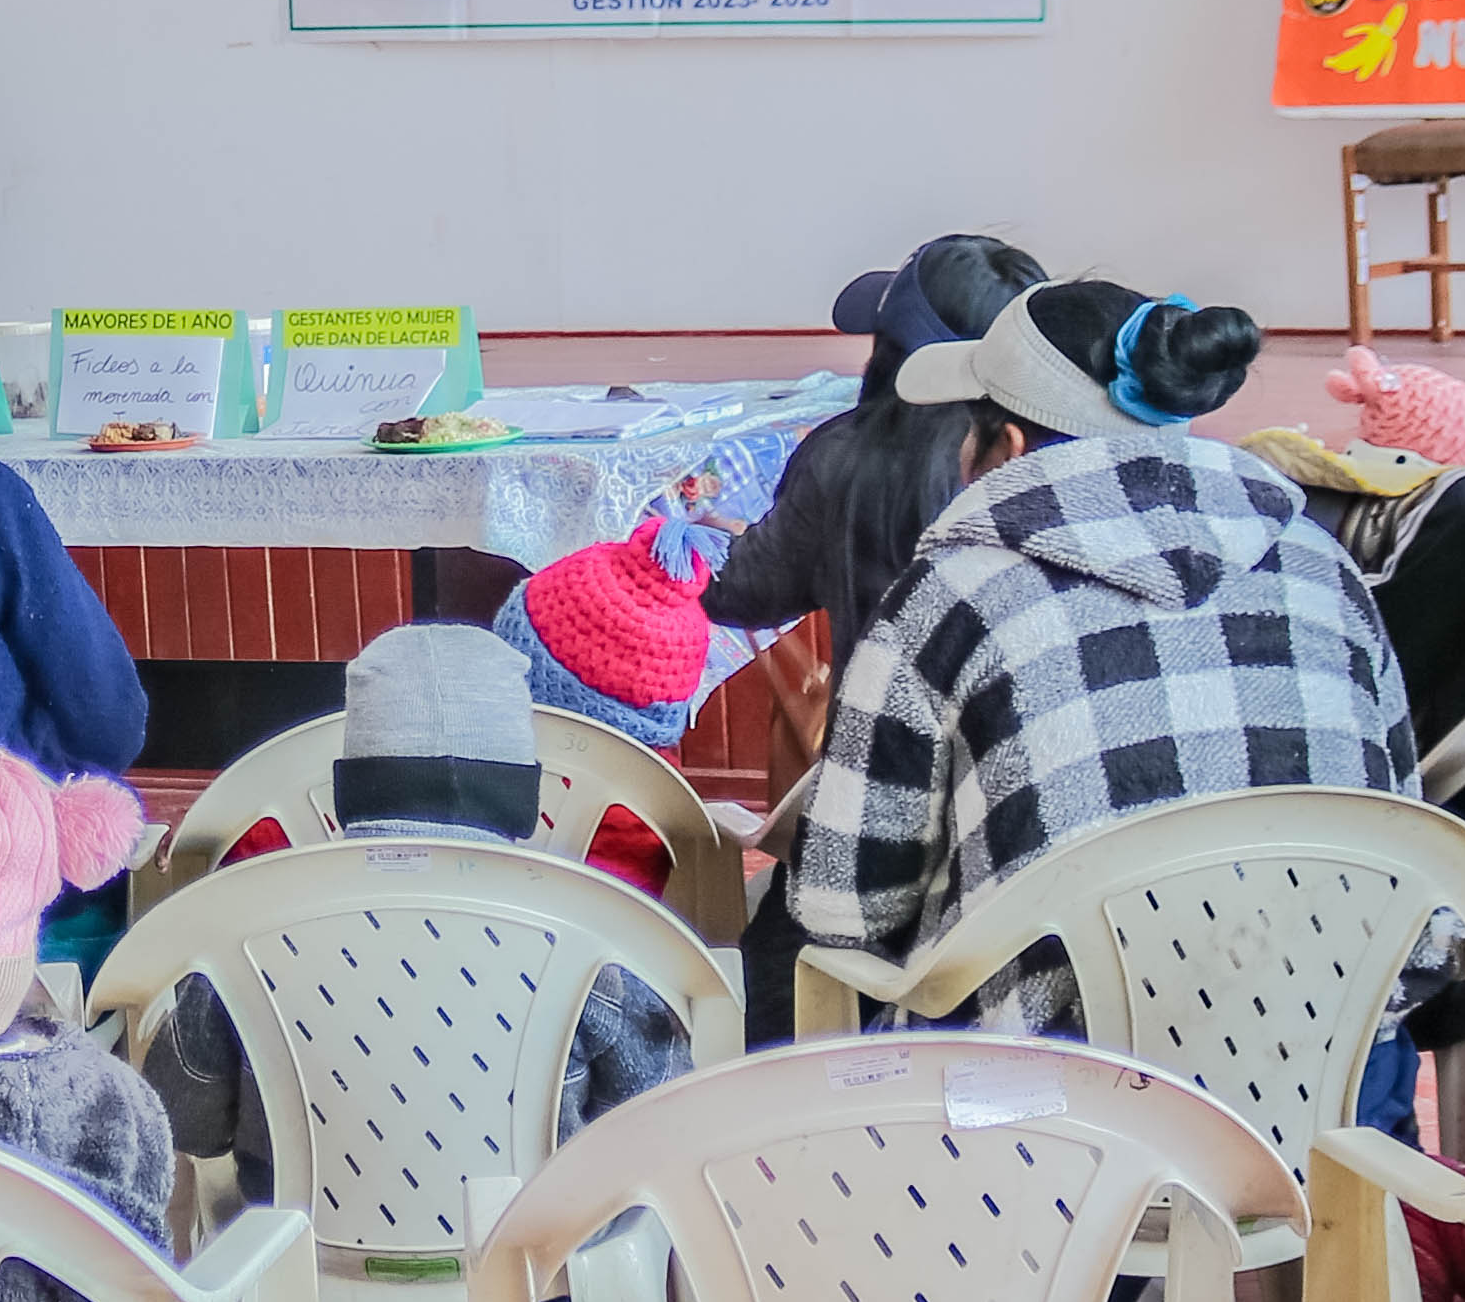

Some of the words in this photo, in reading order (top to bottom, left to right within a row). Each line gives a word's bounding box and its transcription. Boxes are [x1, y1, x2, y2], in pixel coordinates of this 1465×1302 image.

[64, 313, 148, 329] MAYORES
[153, 313, 176, 329] DE
[181, 314, 187, 329] 1
[191, 310, 233, 329] AÑO
[288, 310, 372, 327] GESTANTES
[376, 310, 403, 326] Y/O
[407, 309, 455, 325] MUJER
[292, 331, 325, 348] QUE
[328, 330, 363, 346] DAN
[366, 330, 386, 345] DE
[390, 329, 450, 345] LACTAR
[71, 348, 140, 375] Fideos
[149, 361, 163, 374] a
[170, 355, 201, 375] la
[293, 361, 418, 394] Quinua
